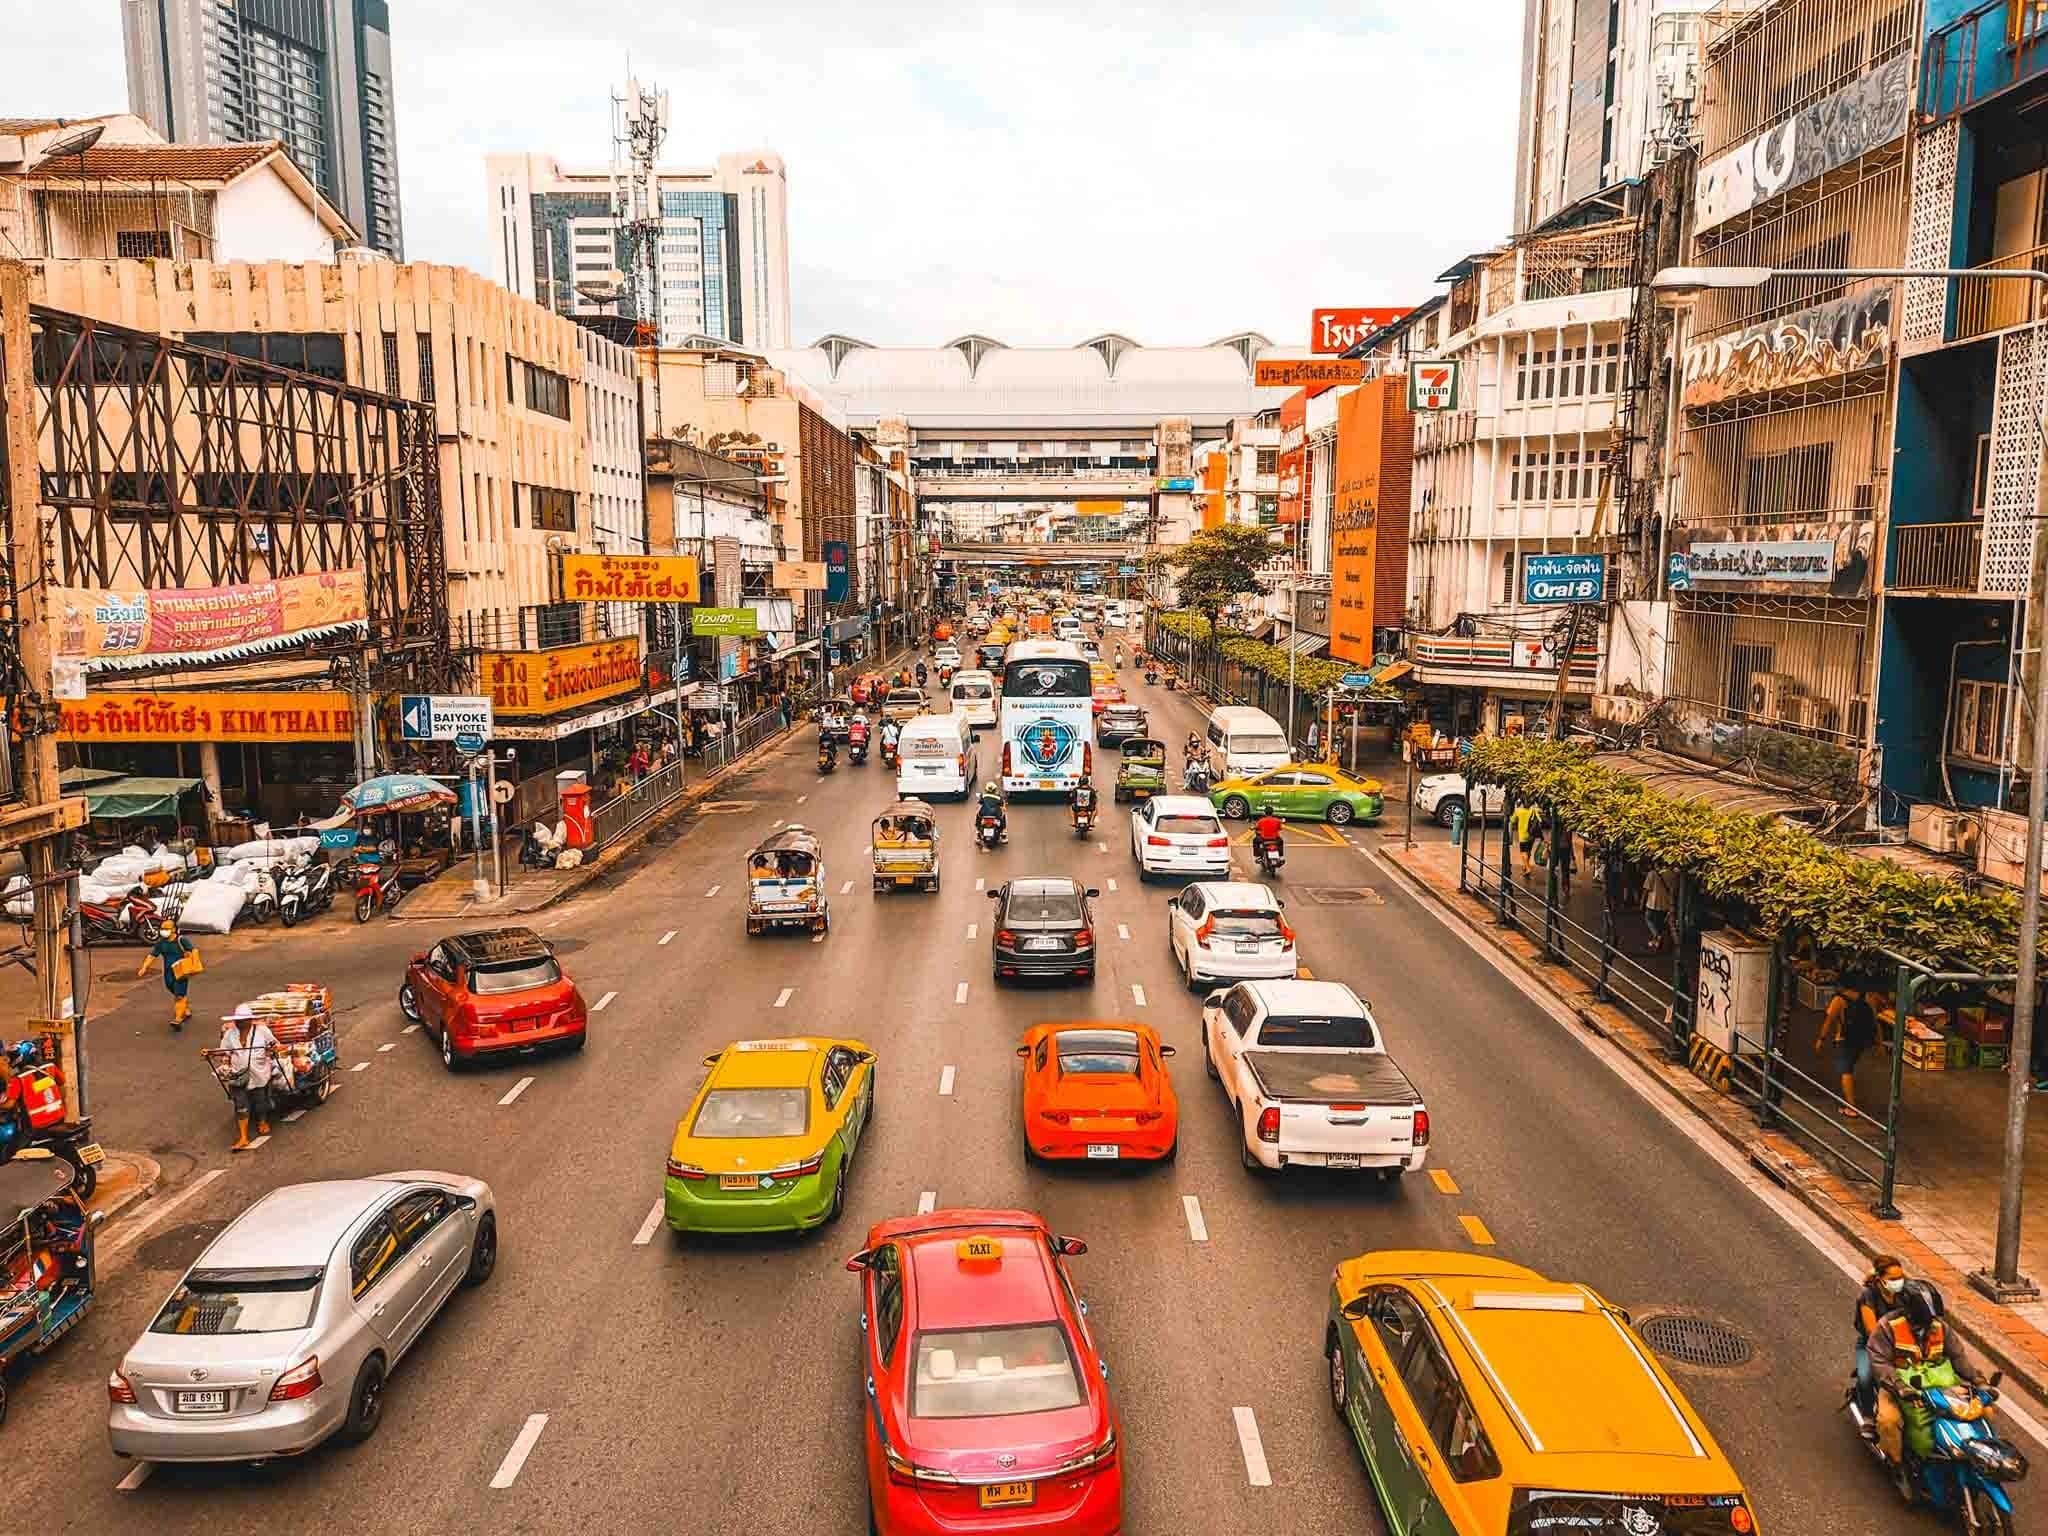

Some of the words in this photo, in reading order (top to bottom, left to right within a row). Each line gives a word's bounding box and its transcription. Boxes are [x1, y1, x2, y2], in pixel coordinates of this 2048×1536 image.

[1421, 369, 1449, 407] 7
[1528, 559, 1601, 576] ทำฟัน-จัดฟัน
[1533, 581, 1594, 599] Oral-B
[102, 623, 144, 650] 39
[220, 711, 267, 733] KIM
[270, 711, 329, 733] THAI
[434, 713, 487, 722] BAIYOKE
[434, 724, 453, 732] SKY
[456, 724, 487, 732] HOTEL
[969, 1243, 991, 1255] TAXI
[200, 1392, 222, 1402] 6911
[1009, 1482, 1028, 1495] 813
